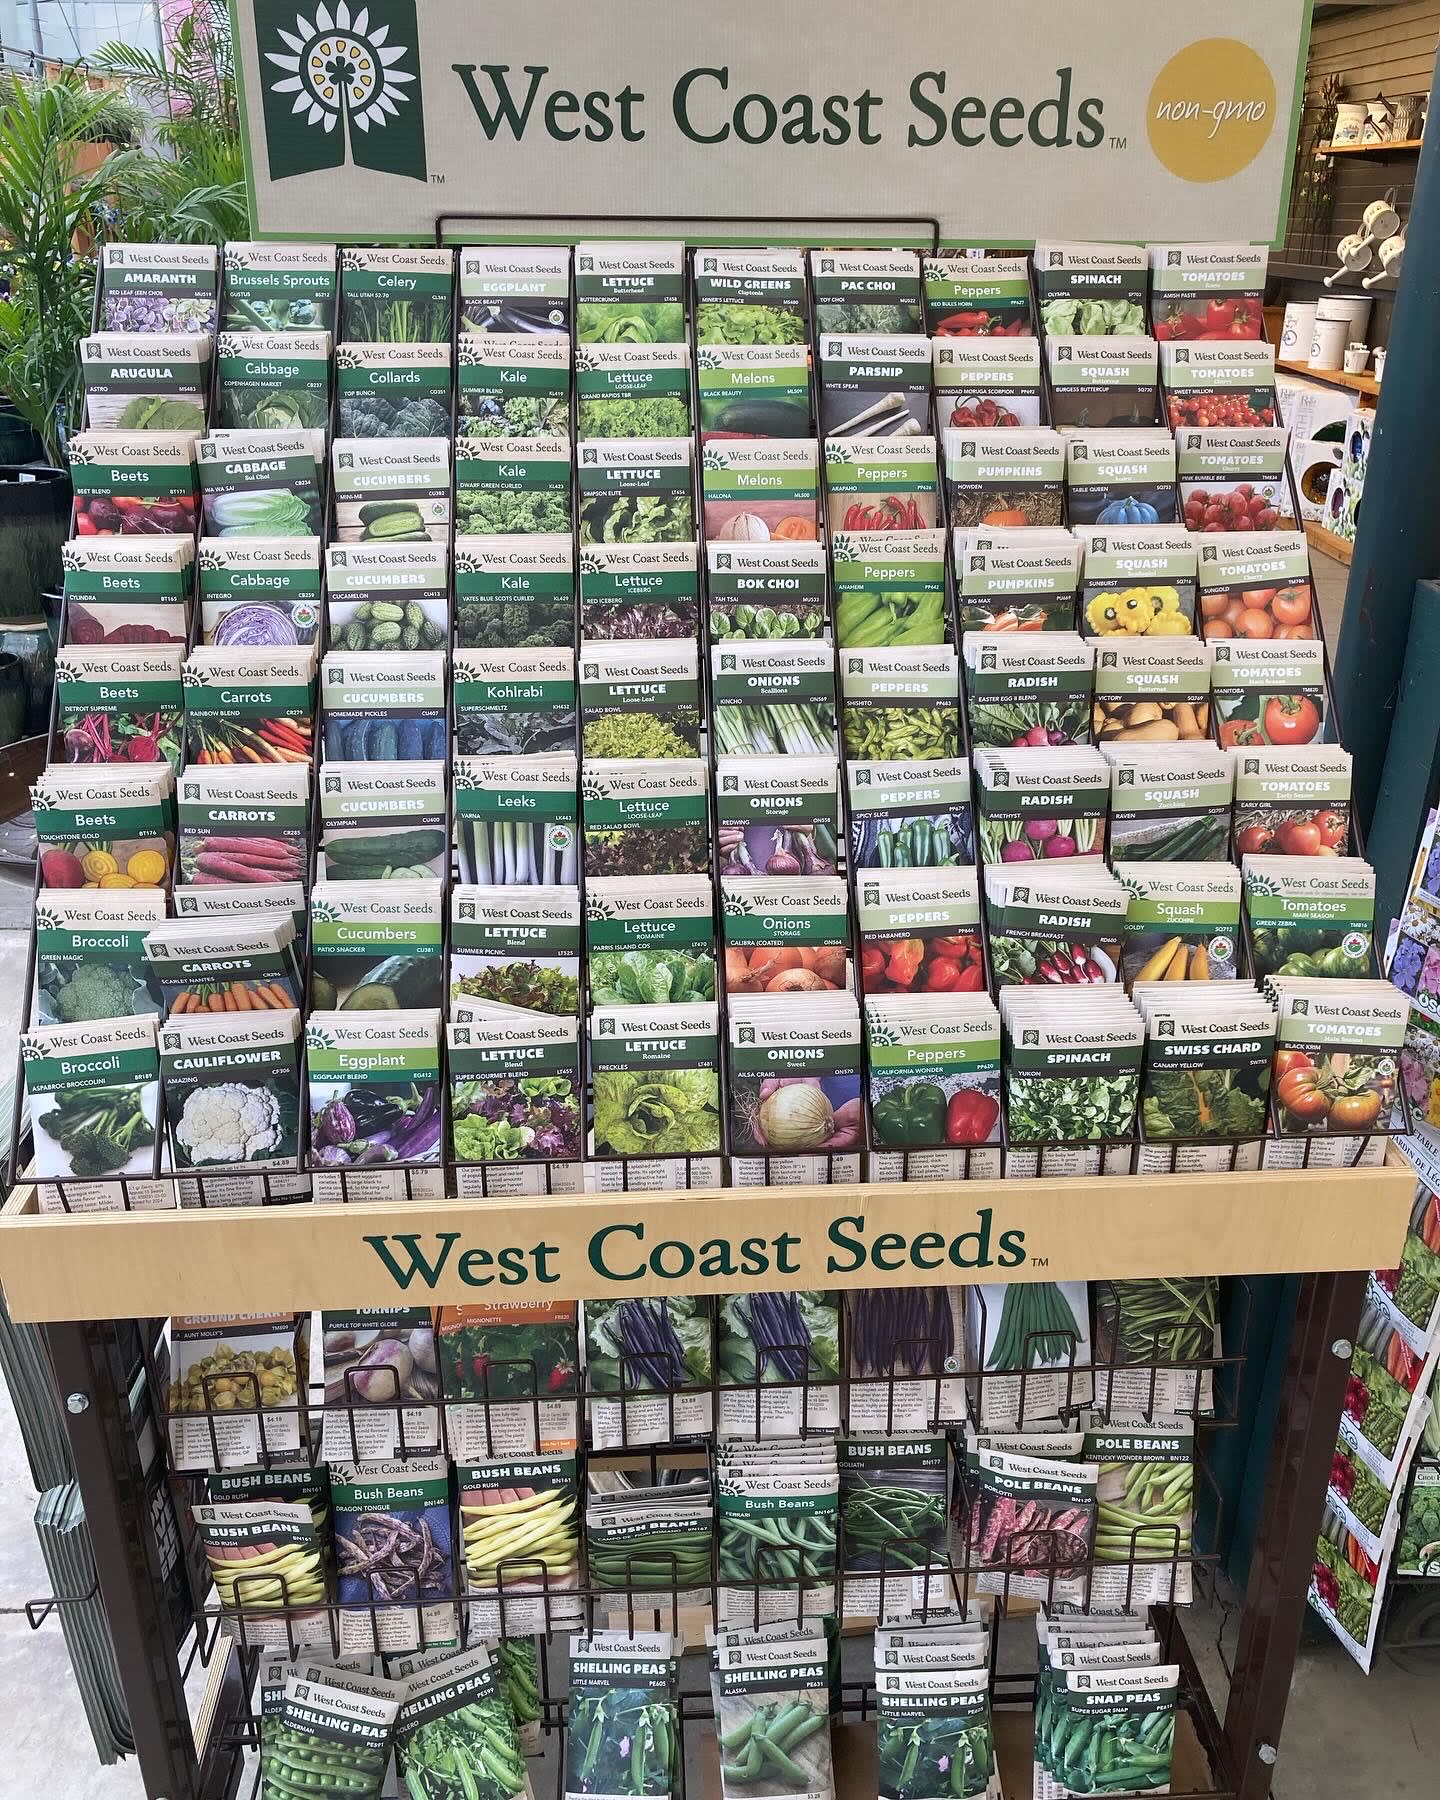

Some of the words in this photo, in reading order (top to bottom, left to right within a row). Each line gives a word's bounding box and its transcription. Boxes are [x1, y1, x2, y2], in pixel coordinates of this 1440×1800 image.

[451, 64, 645, 142] West
[673, 66, 883, 145] Coast
[908, 67, 1104, 148] Seeds
[1154, 94, 1269, 140] non-gmo
[129, 254, 152, 263] West
[154, 255, 180, 263] Coast
[182, 256, 209, 264] Seeds
[124, 273, 196, 284] AMARANTH
[230, 274, 279, 285] Brussels
[283, 275, 330, 288] Sprouts
[378, 275, 416, 290] Celery
[603, 277, 654, 286] LETTUCE
[710, 279, 741, 288] WILD
[744, 280, 791, 289] GREENS
[1071, 275, 1121, 284] SPINACH
[483, 283, 546, 292] EGGPLANT
[841, 281, 864, 290] PAC
[866, 281, 895, 290] CHOI
[954, 285, 1001, 298] Peppers
[111, 368, 173, 378] ARUGULA
[245, 362, 299, 378] Cabbage
[849, 367, 903, 376] PARSNIP
[1191, 368, 1254, 378] TOMATOES
[369, 371, 420, 383] Collards
[501, 371, 527, 382] Kale
[608, 372, 653, 383] Lettuce
[732, 372, 775, 384] Melons
[961, 372, 1014, 381] PEPPERS
[225, 461, 286, 474] CABBAGE
[978, 467, 1042, 476] PUMPKINS
[1098, 465, 1147, 476] SQUASH
[111, 470, 149, 481] Beets
[353, 474, 431, 486] CUCUMBERS
[738, 473, 782, 485] Melons
[857, 468, 908, 481] Peppers
[1116, 559, 1167, 570] SQUASH
[1218, 560, 1286, 576] TOMATOES
[865, 566, 915, 580] Peppers
[103, 576, 140, 588] Beets
[230, 574, 290, 588] Cabbage
[346, 574, 426, 585] CUCUMBERS
[502, 577, 530, 588] Kale
[615, 575, 663, 586] Lettuce
[737, 579, 764, 588] BOK
[767, 579, 799, 589] CHOI
[988, 578, 1054, 589] PUMPKINS
[1232, 667, 1301, 677] TOMATOES
[748, 676, 800, 686] ONIONS
[1008, 677, 1058, 688] RADISH
[1126, 675, 1179, 686] SQUASH
[100, 687, 138, 698] Beets
[488, 685, 543, 698] Kohlrabi
[872, 683, 928, 692] PEPPERS
[221, 691, 272, 703] Carrots
[343, 693, 424, 703] CUCUMBERS
[328, 710, 363, 718] HOMEMADE
[364, 710, 387, 718] PICKLES
[1260, 782, 1330, 791] TOMATOES
[498, 795, 536, 807] Leeks
[880, 789, 940, 803] PEPPERS
[1021, 795, 1073, 805] RADISH
[1145, 789, 1199, 802] SQUASH
[619, 801, 669, 812] Lettuce
[750, 797, 803, 807] ONIONS
[75, 814, 116, 826] Beets
[209, 810, 276, 821] CARROTS
[1157, 903, 1204, 918] Squash
[1281, 899, 1346, 912] Tomatoes
[763, 917, 811, 929] Onions
[889, 911, 950, 924] PEPPERS
[1039, 915, 1091, 927] RADISH
[337, 927, 416, 939] Cucumbers
[485, 928, 547, 938] LETTUCE
[625, 922, 675, 933] Lettuce
[72, 935, 128, 947] Broccoli
[182, 960, 252, 972] CARROTS
[1307, 1024, 1382, 1036] TOMATOES
[1046, 1035, 1072, 1043] West
[1074, 1034, 1105, 1043] Coast
[1106, 1032, 1137, 1042] Seeds
[626, 1040, 686, 1051] LETTUCE
[1164, 1043, 1208, 1057] SWISS
[1211, 1040, 1262, 1056] CHARD
[173, 1050, 282, 1070] CAULIFLOWER
[481, 1048, 544, 1061] LETTUCE
[768, 1049, 824, 1060] ONIONS
[908, 1050, 966, 1063] Peppers
[1047, 1053, 1111, 1063] SPINACH
[61, 1056, 120, 1074] Broccoli
[339, 1053, 405, 1070] Eggplant
[599, 1063, 628, 1071] FRECKLES
[698, 1060, 712, 1068] LT481
[877, 1068, 914, 1076] CALIFORNIA
[915, 1066, 943, 1074] WONDER
[362, 1232, 560, 1290] West
[588, 1222, 801, 1281] Coast
[827, 1208, 1026, 1273] Seeds
[484, 1301, 554, 1313] Strawberry
[467, 1316, 501, 1324] MIGNONETTE
[1096, 1439, 1130, 1449] POLE
[1134, 1439, 1179, 1449] BEANS
[848, 1446, 884, 1456] BUSH
[888, 1444, 932, 1455] BEANS
[1143, 1454, 1165, 1462] BROWN
[472, 1468, 510, 1479] BUSH
[514, 1464, 561, 1476] BEANS
[222, 1475, 261, 1489] BUSH
[265, 1473, 311, 1484] BEANS
[994, 1476, 1030, 1490] POLE
[1034, 1482, 1082, 1494] BEANS
[354, 1488, 383, 1500] Bush
[387, 1488, 423, 1498] Beans
[336, 1505, 362, 1513] DRAGON
[746, 1500, 774, 1508] Bush
[779, 1500, 815, 1508] Beans
[209, 1528, 248, 1536] BUSH
[251, 1524, 300, 1534] BEANS
[607, 1525, 646, 1536] BUSH
[649, 1519, 698, 1530] BEANS
[574, 1663, 631, 1674] SHELLING
[634, 1664, 666, 1674] PEAS
[724, 1669, 787, 1683] SHELLING
[790, 1667, 823, 1678] PEAS
[573, 1678, 587, 1686] LITTLE
[1087, 1695, 1122, 1704] SNAP
[1126, 1693, 1160, 1703] PEAS
[285, 1705, 350, 1731] SHELLING
[351, 1722, 388, 1739] PEAS
